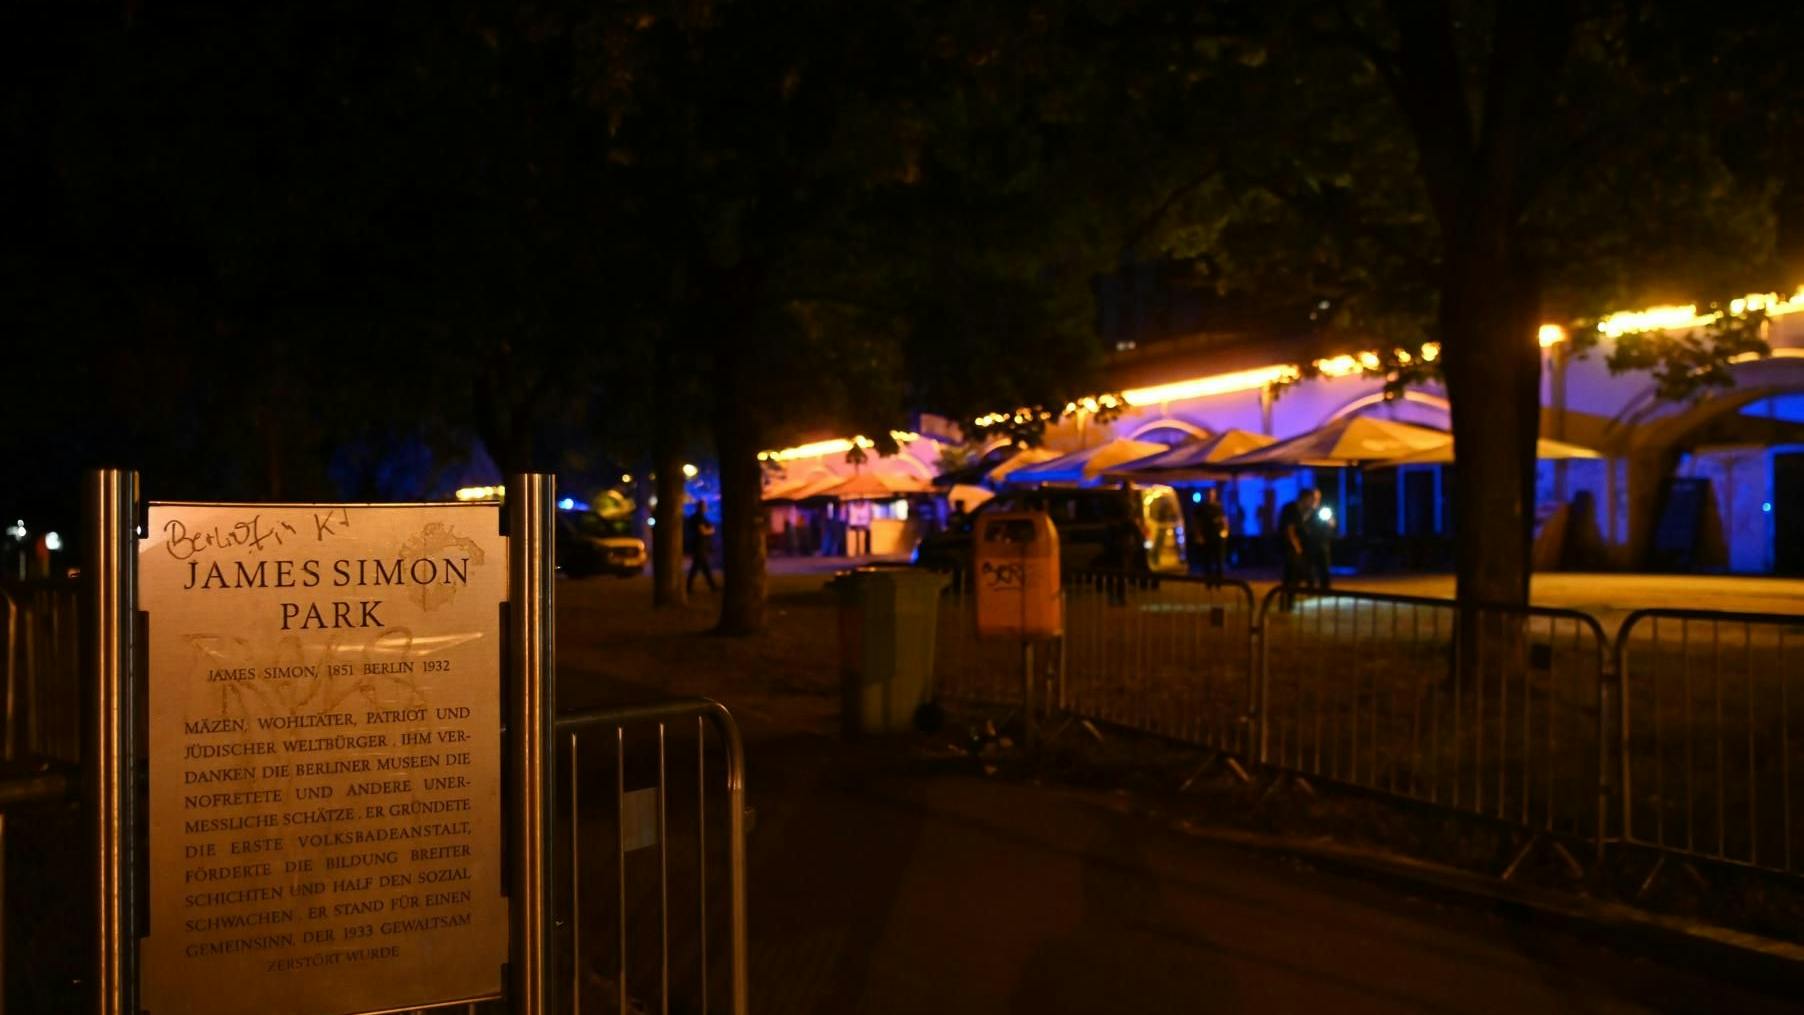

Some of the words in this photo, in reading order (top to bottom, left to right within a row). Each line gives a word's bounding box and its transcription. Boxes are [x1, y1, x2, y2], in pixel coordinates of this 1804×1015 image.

[184, 559, 320, 589] JAMES
[333, 557, 470, 587] SIMON
[281, 600, 385, 630] PARK
[208, 668, 256, 682] JAMES
[264, 666, 319, 680] SIMON,
[327, 664, 354, 677] 1851
[364, 661, 414, 675] BERLIN
[423, 660, 450, 672] 1932
[184, 717, 248, 735] MÄZEN,
[258, 711, 357, 730] WOHLTÄTER,
[366, 708, 427, 725] PATRIOT
[436, 707, 470, 720] UND
[184, 741, 276, 759] JÜDISCHER
[401, 732, 432, 746] IHM
[438, 730, 471, 743] VER-
[185, 766, 256, 785] DANKEN
[262, 764, 289, 779] DIE
[295, 760, 371, 777] BERLINER
[377, 753, 440, 771] MUSEEN
[446, 752, 470, 766] DIE
[184, 789, 282, 809] NOFRETETE
[295, 786, 333, 800] UND
[345, 780, 412, 797] ANDERE
[424, 776, 471, 790] UNER-
[184, 814, 279, 834] MESSLICHE
[365, 806, 385, 818] ER
[389, 799, 471, 817] GRÜNDETE
[185, 843, 216, 858] DIE
[231, 838, 284, 855] ERSTE
[298, 822, 472, 849] VOLKSBADEANSTALT,
[185, 863, 272, 883] FÖRDERTE
[285, 859, 313, 873] DIE
[326, 852, 398, 870] BILDUNG
[410, 844, 471, 862] BREITER
[184, 886, 283, 909] SCHICHTEN
[289, 882, 326, 897] UND
[333, 877, 374, 893] HALF
[379, 874, 412, 888] DEN
[417, 867, 471, 884] SOZIAL
[307, 906, 327, 920] ER
[334, 899, 384, 916] STAND
[391, 894, 419, 910] FÜR
[425, 891, 471, 907] EINEN
[303, 929, 335, 944] DER
[344, 925, 373, 940] 1933
[380, 912, 472, 935] GEWALTSAM
[266, 953, 341, 973] ZERSTÖRT
[346, 946, 400, 963] WURDE
